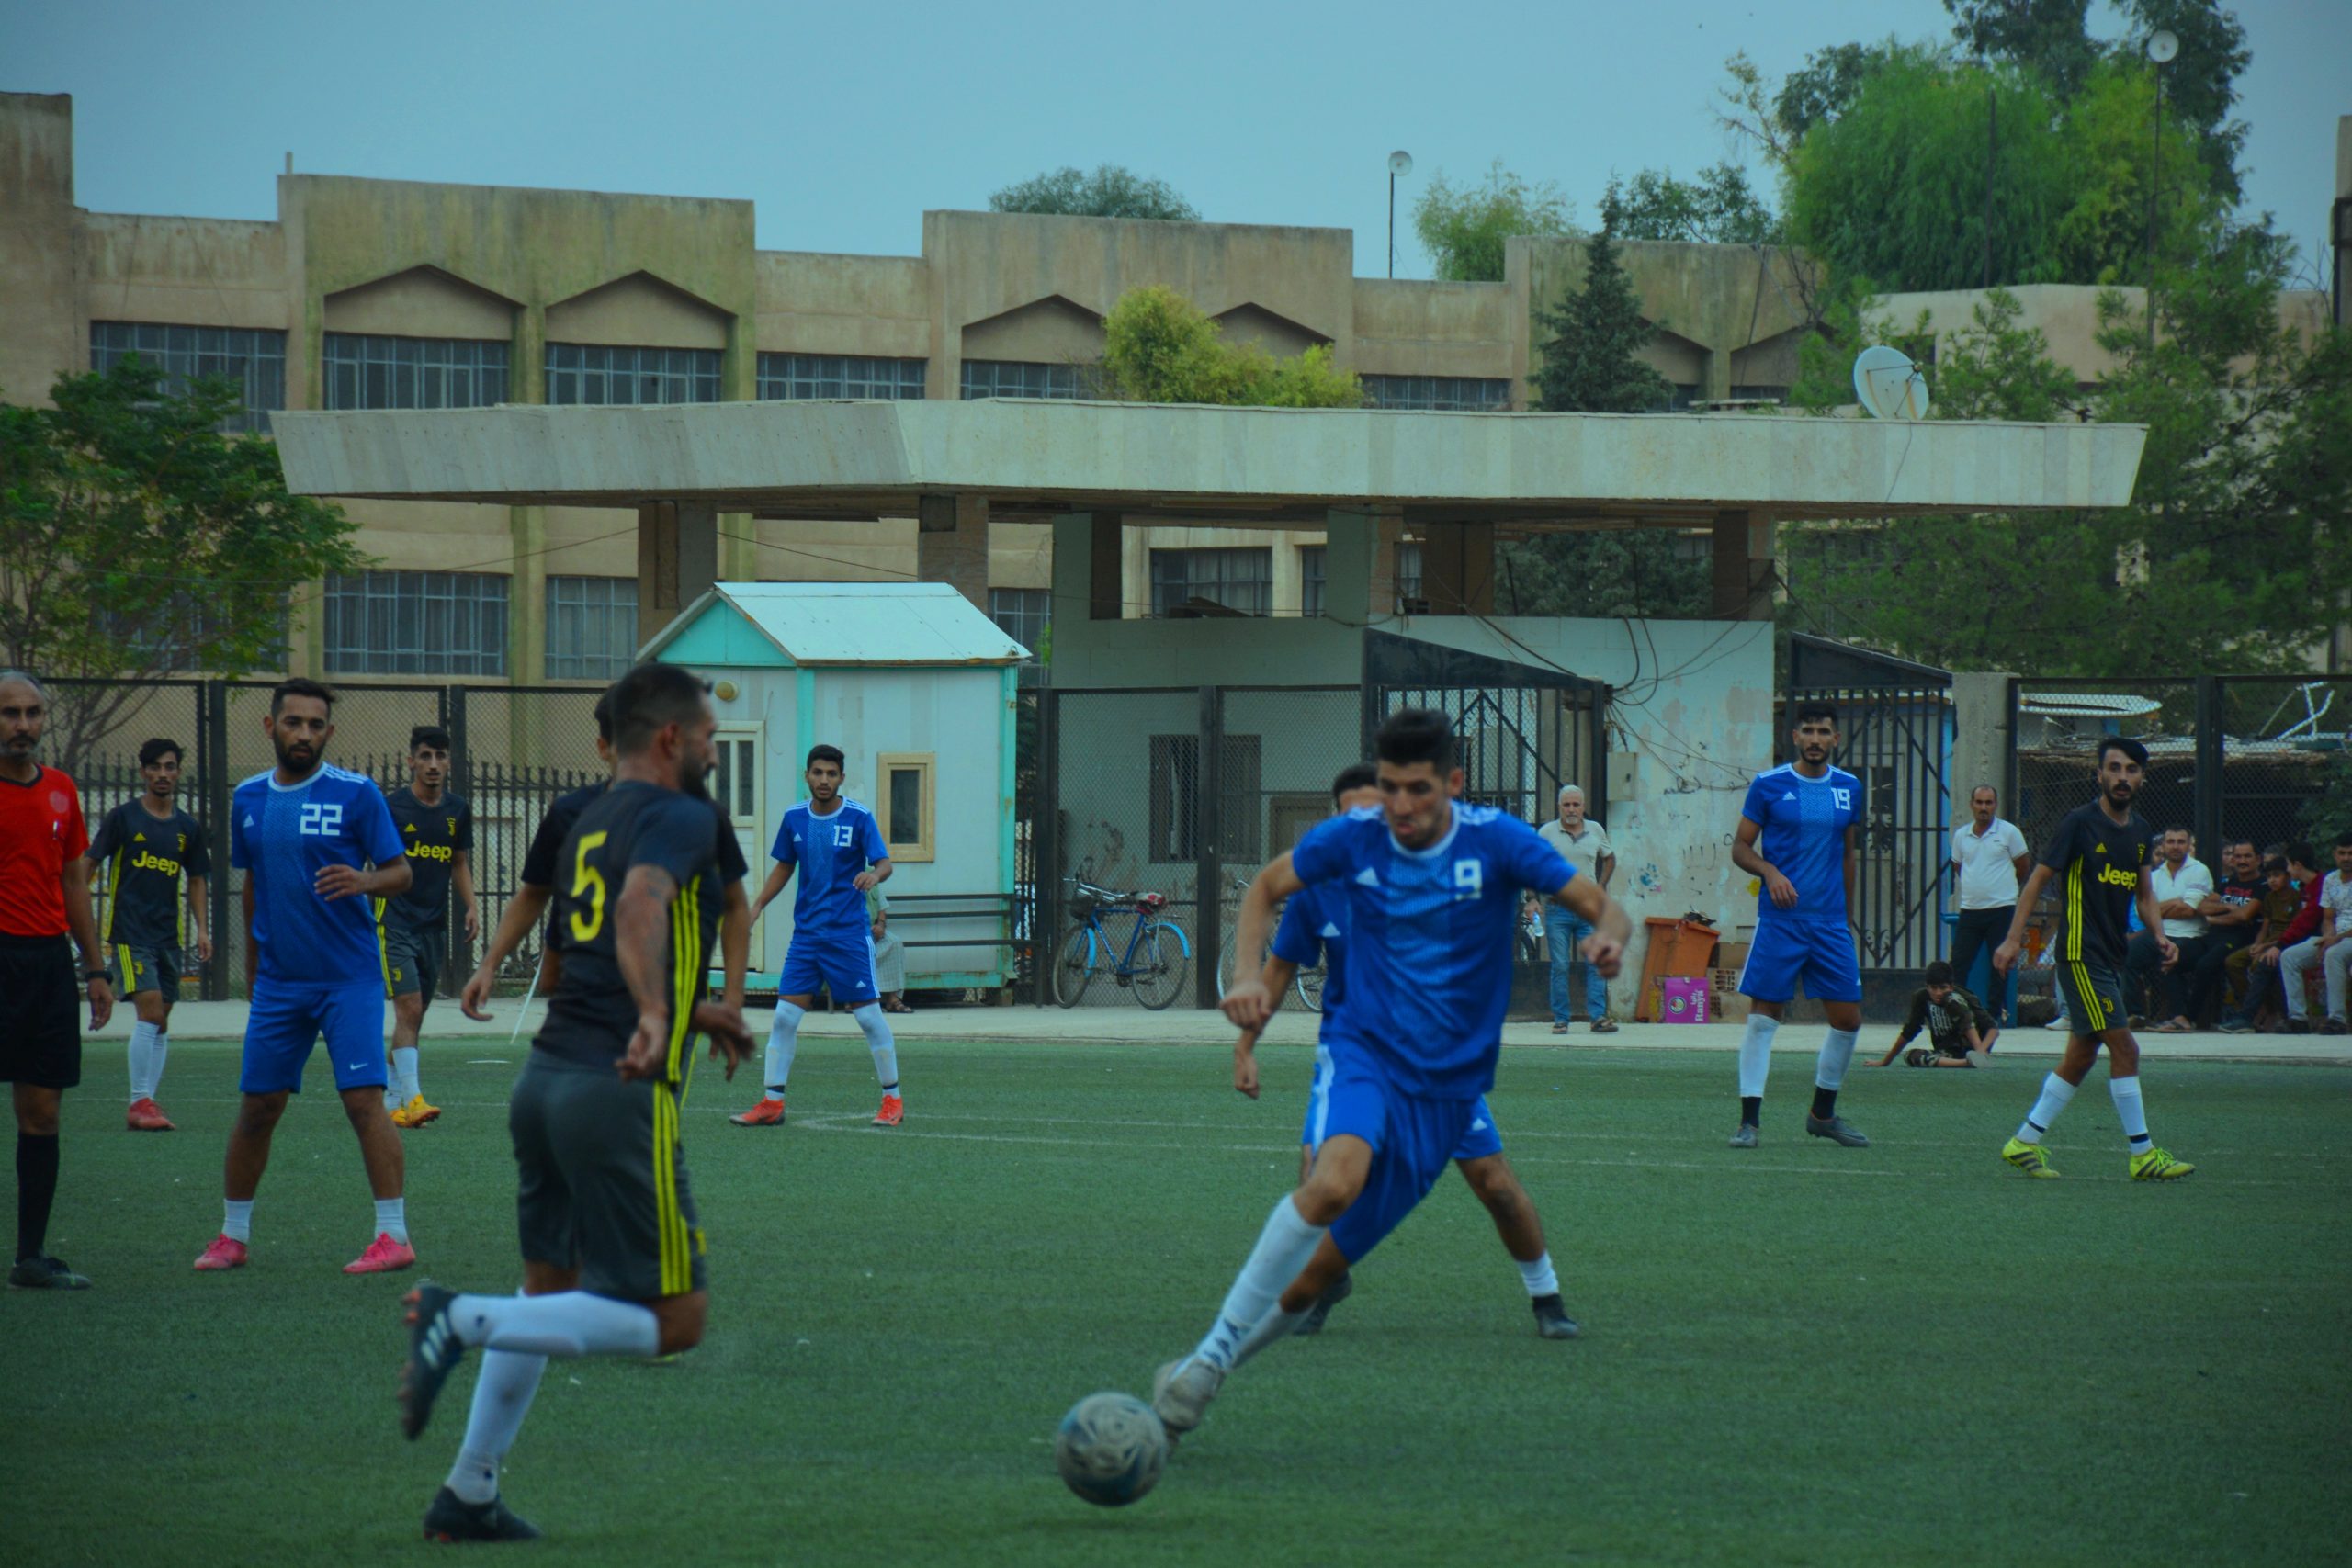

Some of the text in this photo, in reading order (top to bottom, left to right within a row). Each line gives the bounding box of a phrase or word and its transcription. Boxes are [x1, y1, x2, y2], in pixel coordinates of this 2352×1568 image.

[1831, 787, 1851, 810] 19
[300, 803, 343, 836] 22
[833, 825, 853, 847] 13
[132, 851, 179, 876] Jeep
[405, 840, 452, 863] Jeep
[571, 829, 607, 942] 5
[1454, 859, 1483, 901] 9
[2098, 863, 2137, 890] Jeep
